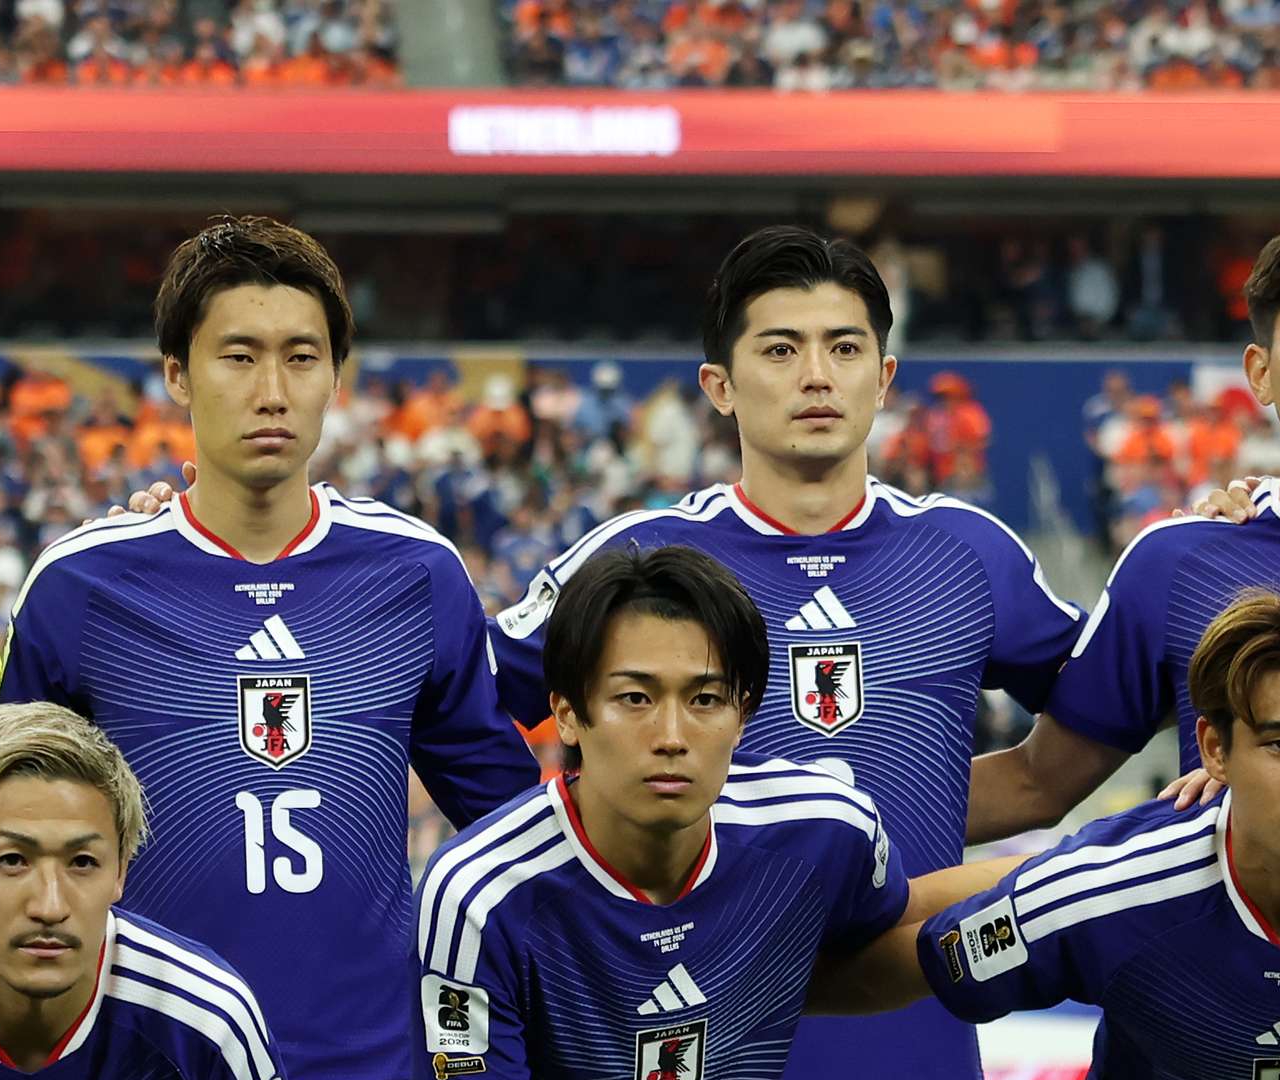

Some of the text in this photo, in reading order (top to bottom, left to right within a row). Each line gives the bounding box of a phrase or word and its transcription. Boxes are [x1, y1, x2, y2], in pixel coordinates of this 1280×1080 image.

[806, 647, 843, 656] JAPAN
[255, 679, 292, 688] JAPAN
[813, 706, 843, 719] JFA
[260, 739, 290, 751] JFA
[235, 789, 323, 894] 15
[966, 930, 979, 964] 2026
[446, 1020, 462, 1028] FIFA
[654, 1026, 690, 1039] JAPAN
[440, 1039, 470, 1047] 2026
[447, 1060, 480, 1069] DEBUT
